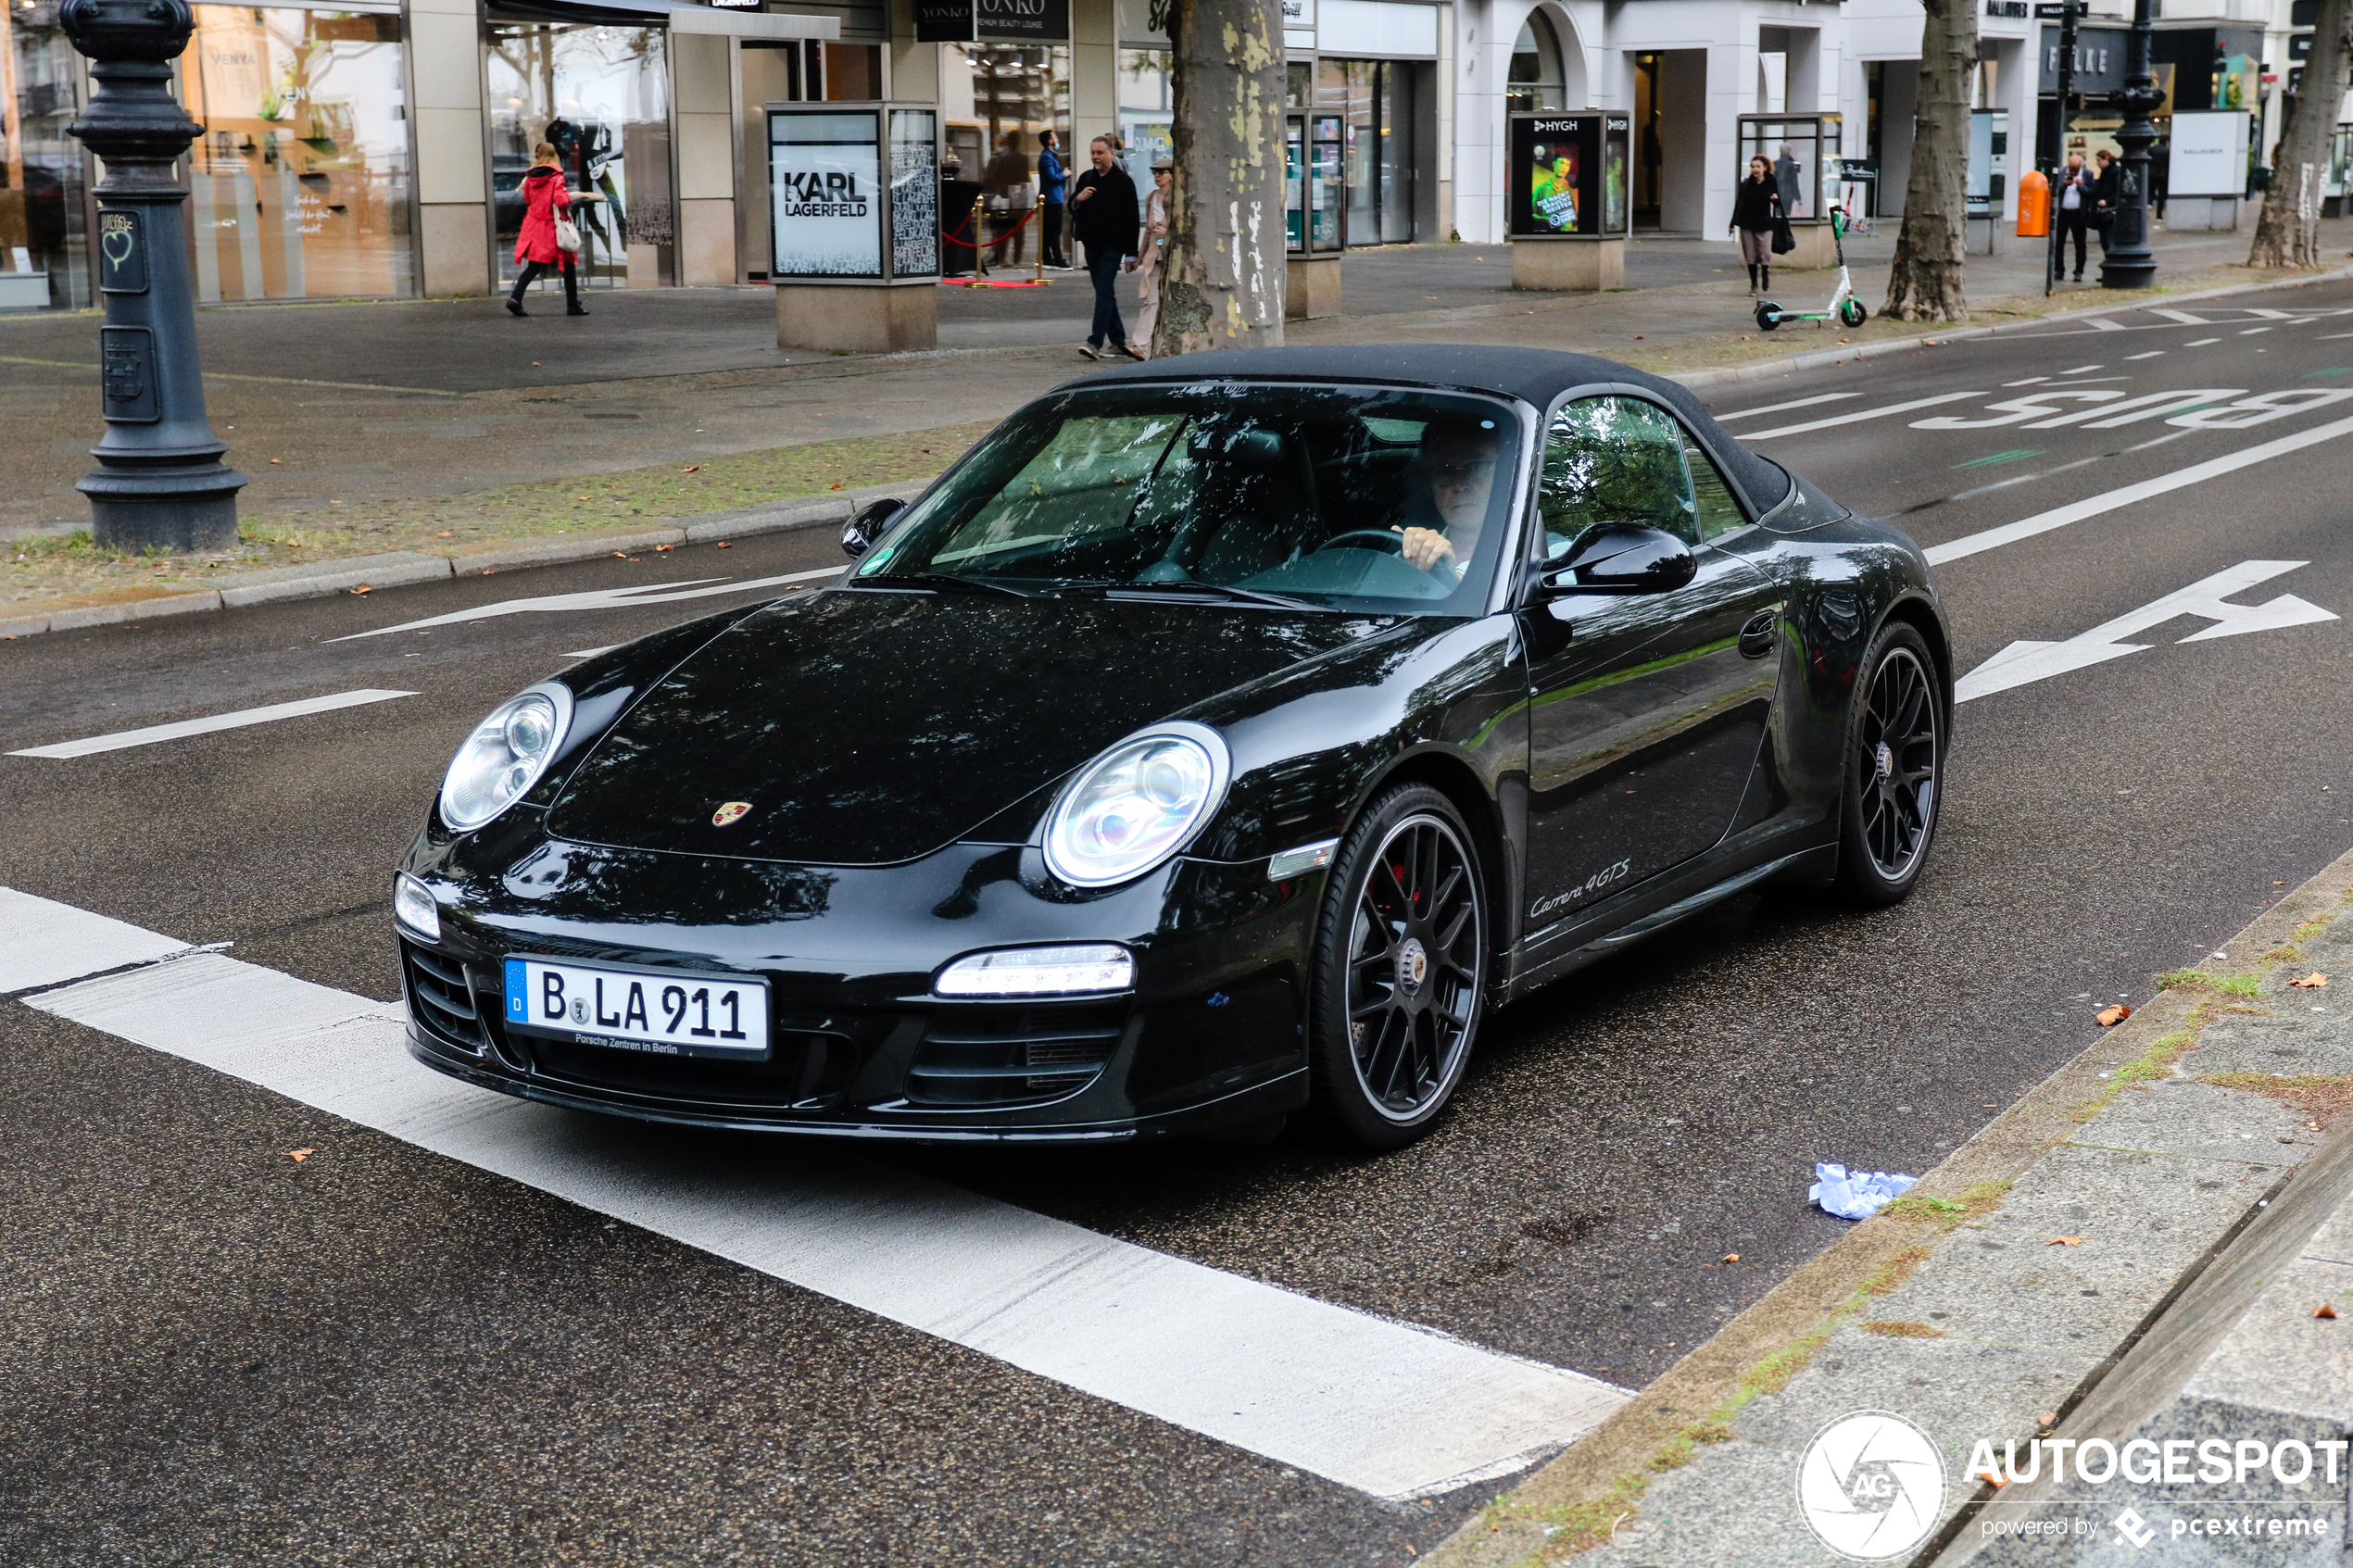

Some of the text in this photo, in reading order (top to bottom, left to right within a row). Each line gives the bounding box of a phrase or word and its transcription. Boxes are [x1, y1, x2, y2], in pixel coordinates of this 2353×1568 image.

[923, 6, 969, 18] YONKO
[999, 19, 1020, 28] BEAUTY
[1022, 20, 1042, 29] LOUNGE
[211, 54, 256, 65] VENYA
[2048, 46, 2108, 73] FLKE
[1545, 120, 1578, 132] HYGH
[785, 172, 867, 202] KARL
[786, 203, 867, 218] LAGERFELD
[1530, 884, 1583, 918] Carrera
[513, 997, 521, 1011] D
[542, 971, 567, 1020] B
[596, 977, 649, 1032] LA
[661, 985, 747, 1040] 911
[575, 1033, 678, 1055] Porsche Zentren in Berlin
